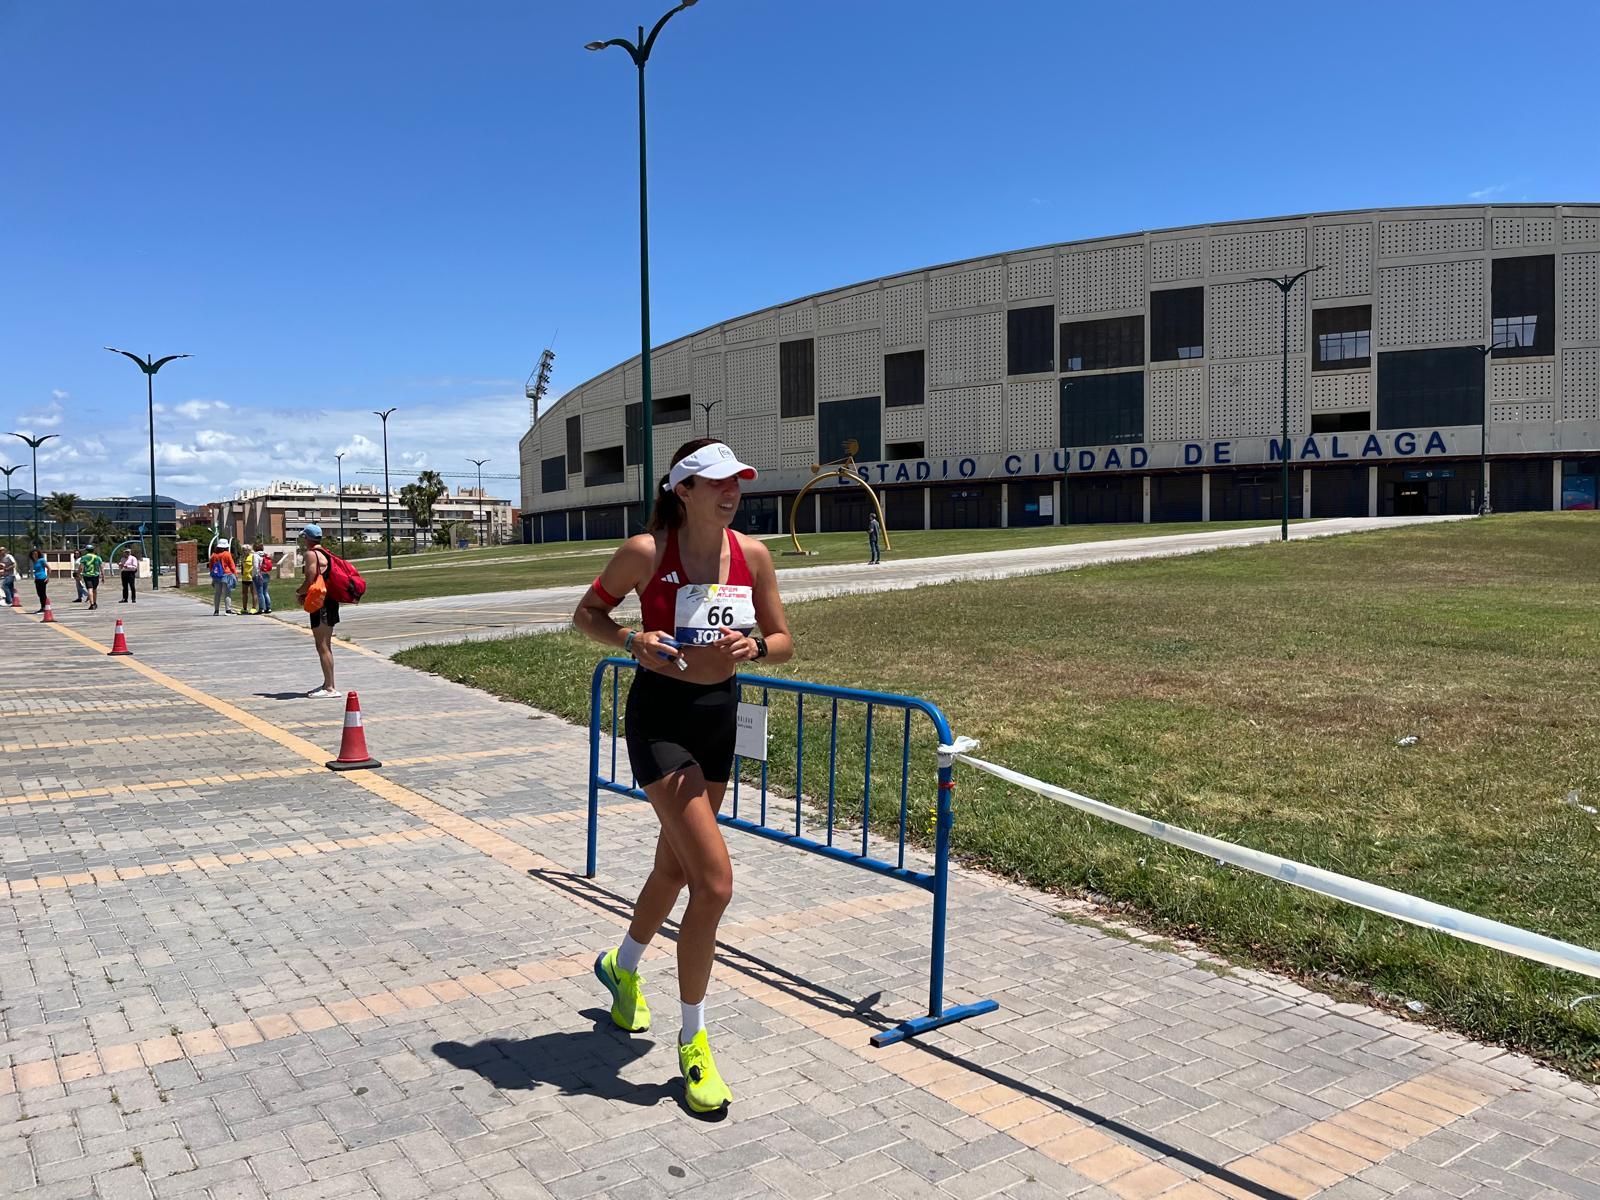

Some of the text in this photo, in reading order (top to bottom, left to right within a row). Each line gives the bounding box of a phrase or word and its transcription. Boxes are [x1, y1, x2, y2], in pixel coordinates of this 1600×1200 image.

[1005, 447, 1148, 475] CIUDAD
[1184, 442, 1231, 465] DE
[707, 605, 734, 626] 66
